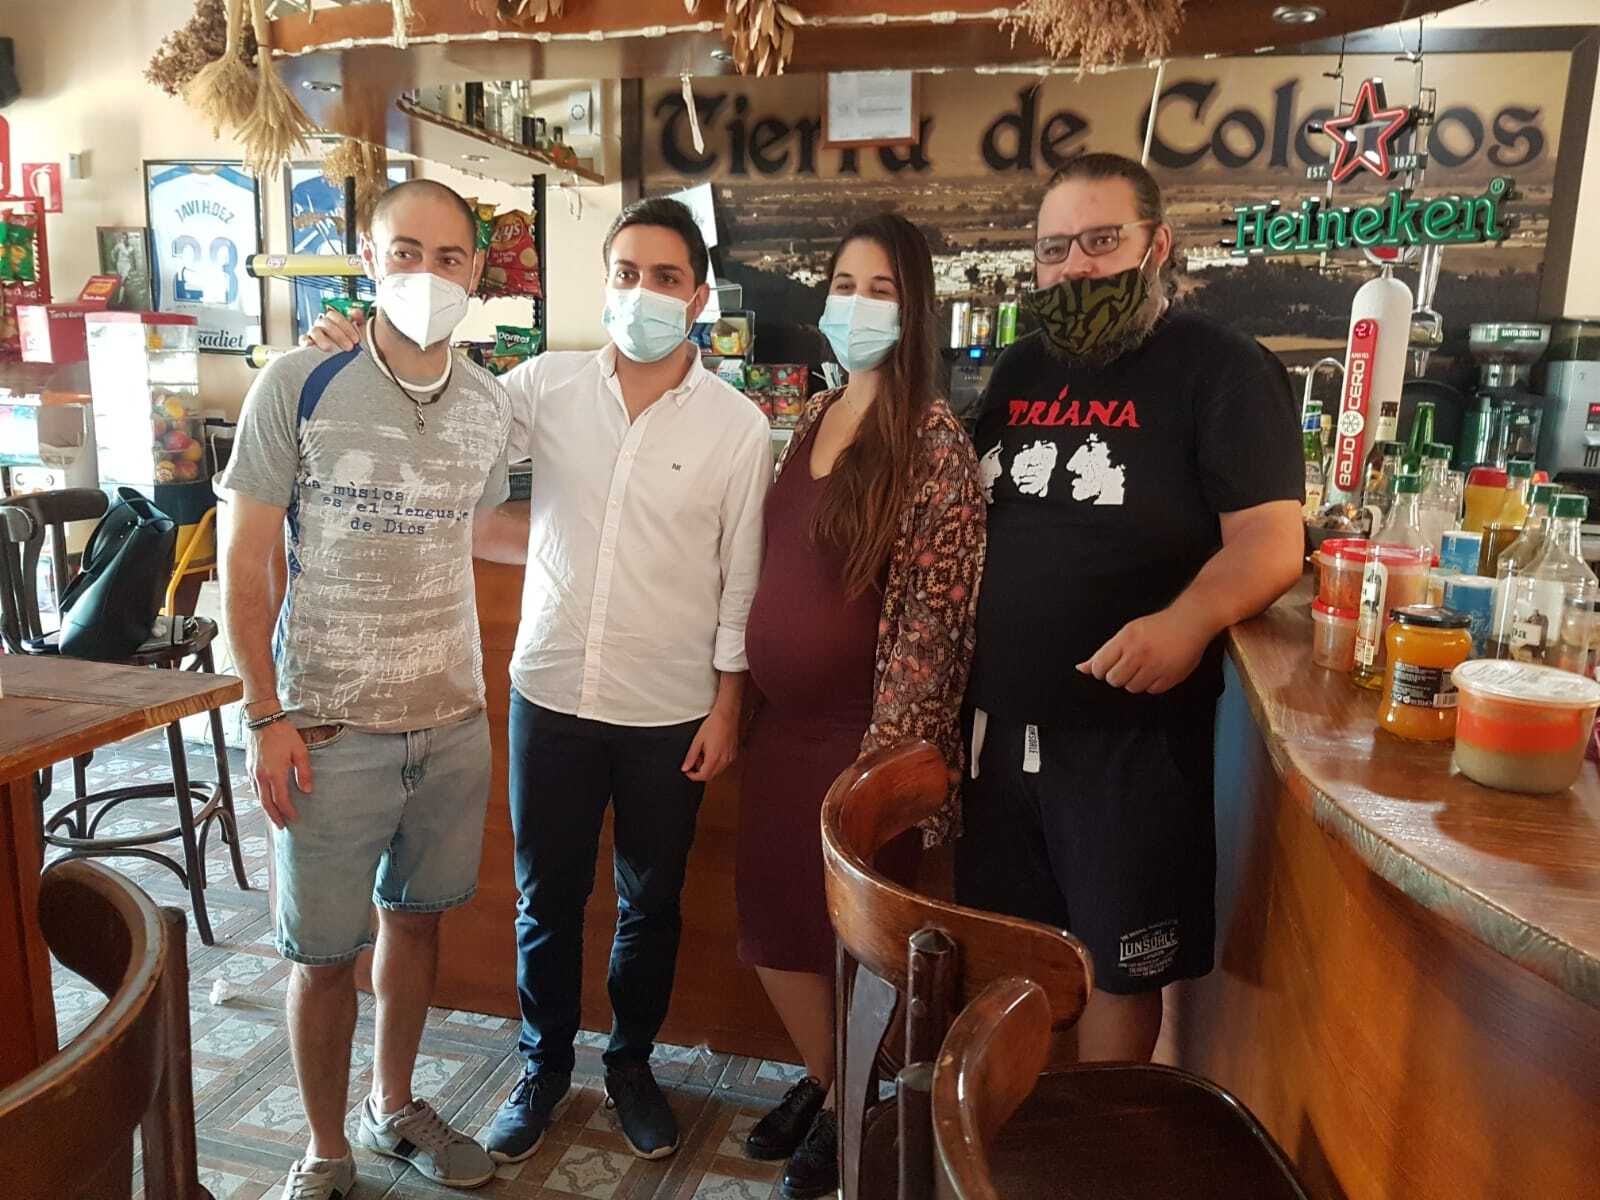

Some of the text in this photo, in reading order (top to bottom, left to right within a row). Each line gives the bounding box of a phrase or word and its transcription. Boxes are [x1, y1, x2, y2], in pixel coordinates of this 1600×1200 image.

[980, 84, 1088, 169] de
[1306, 166, 1328, 179] EST.
[1394, 155, 1417, 168] 1873
[1232, 192, 1502, 256] Heineken
[171, 235, 238, 304] 23
[498, 331, 530, 344] Doritos
[1348, 360, 1365, 410] CERO
[322, 496, 468, 521] es el lenguaje
[350, 518, 426, 535] de Dios
